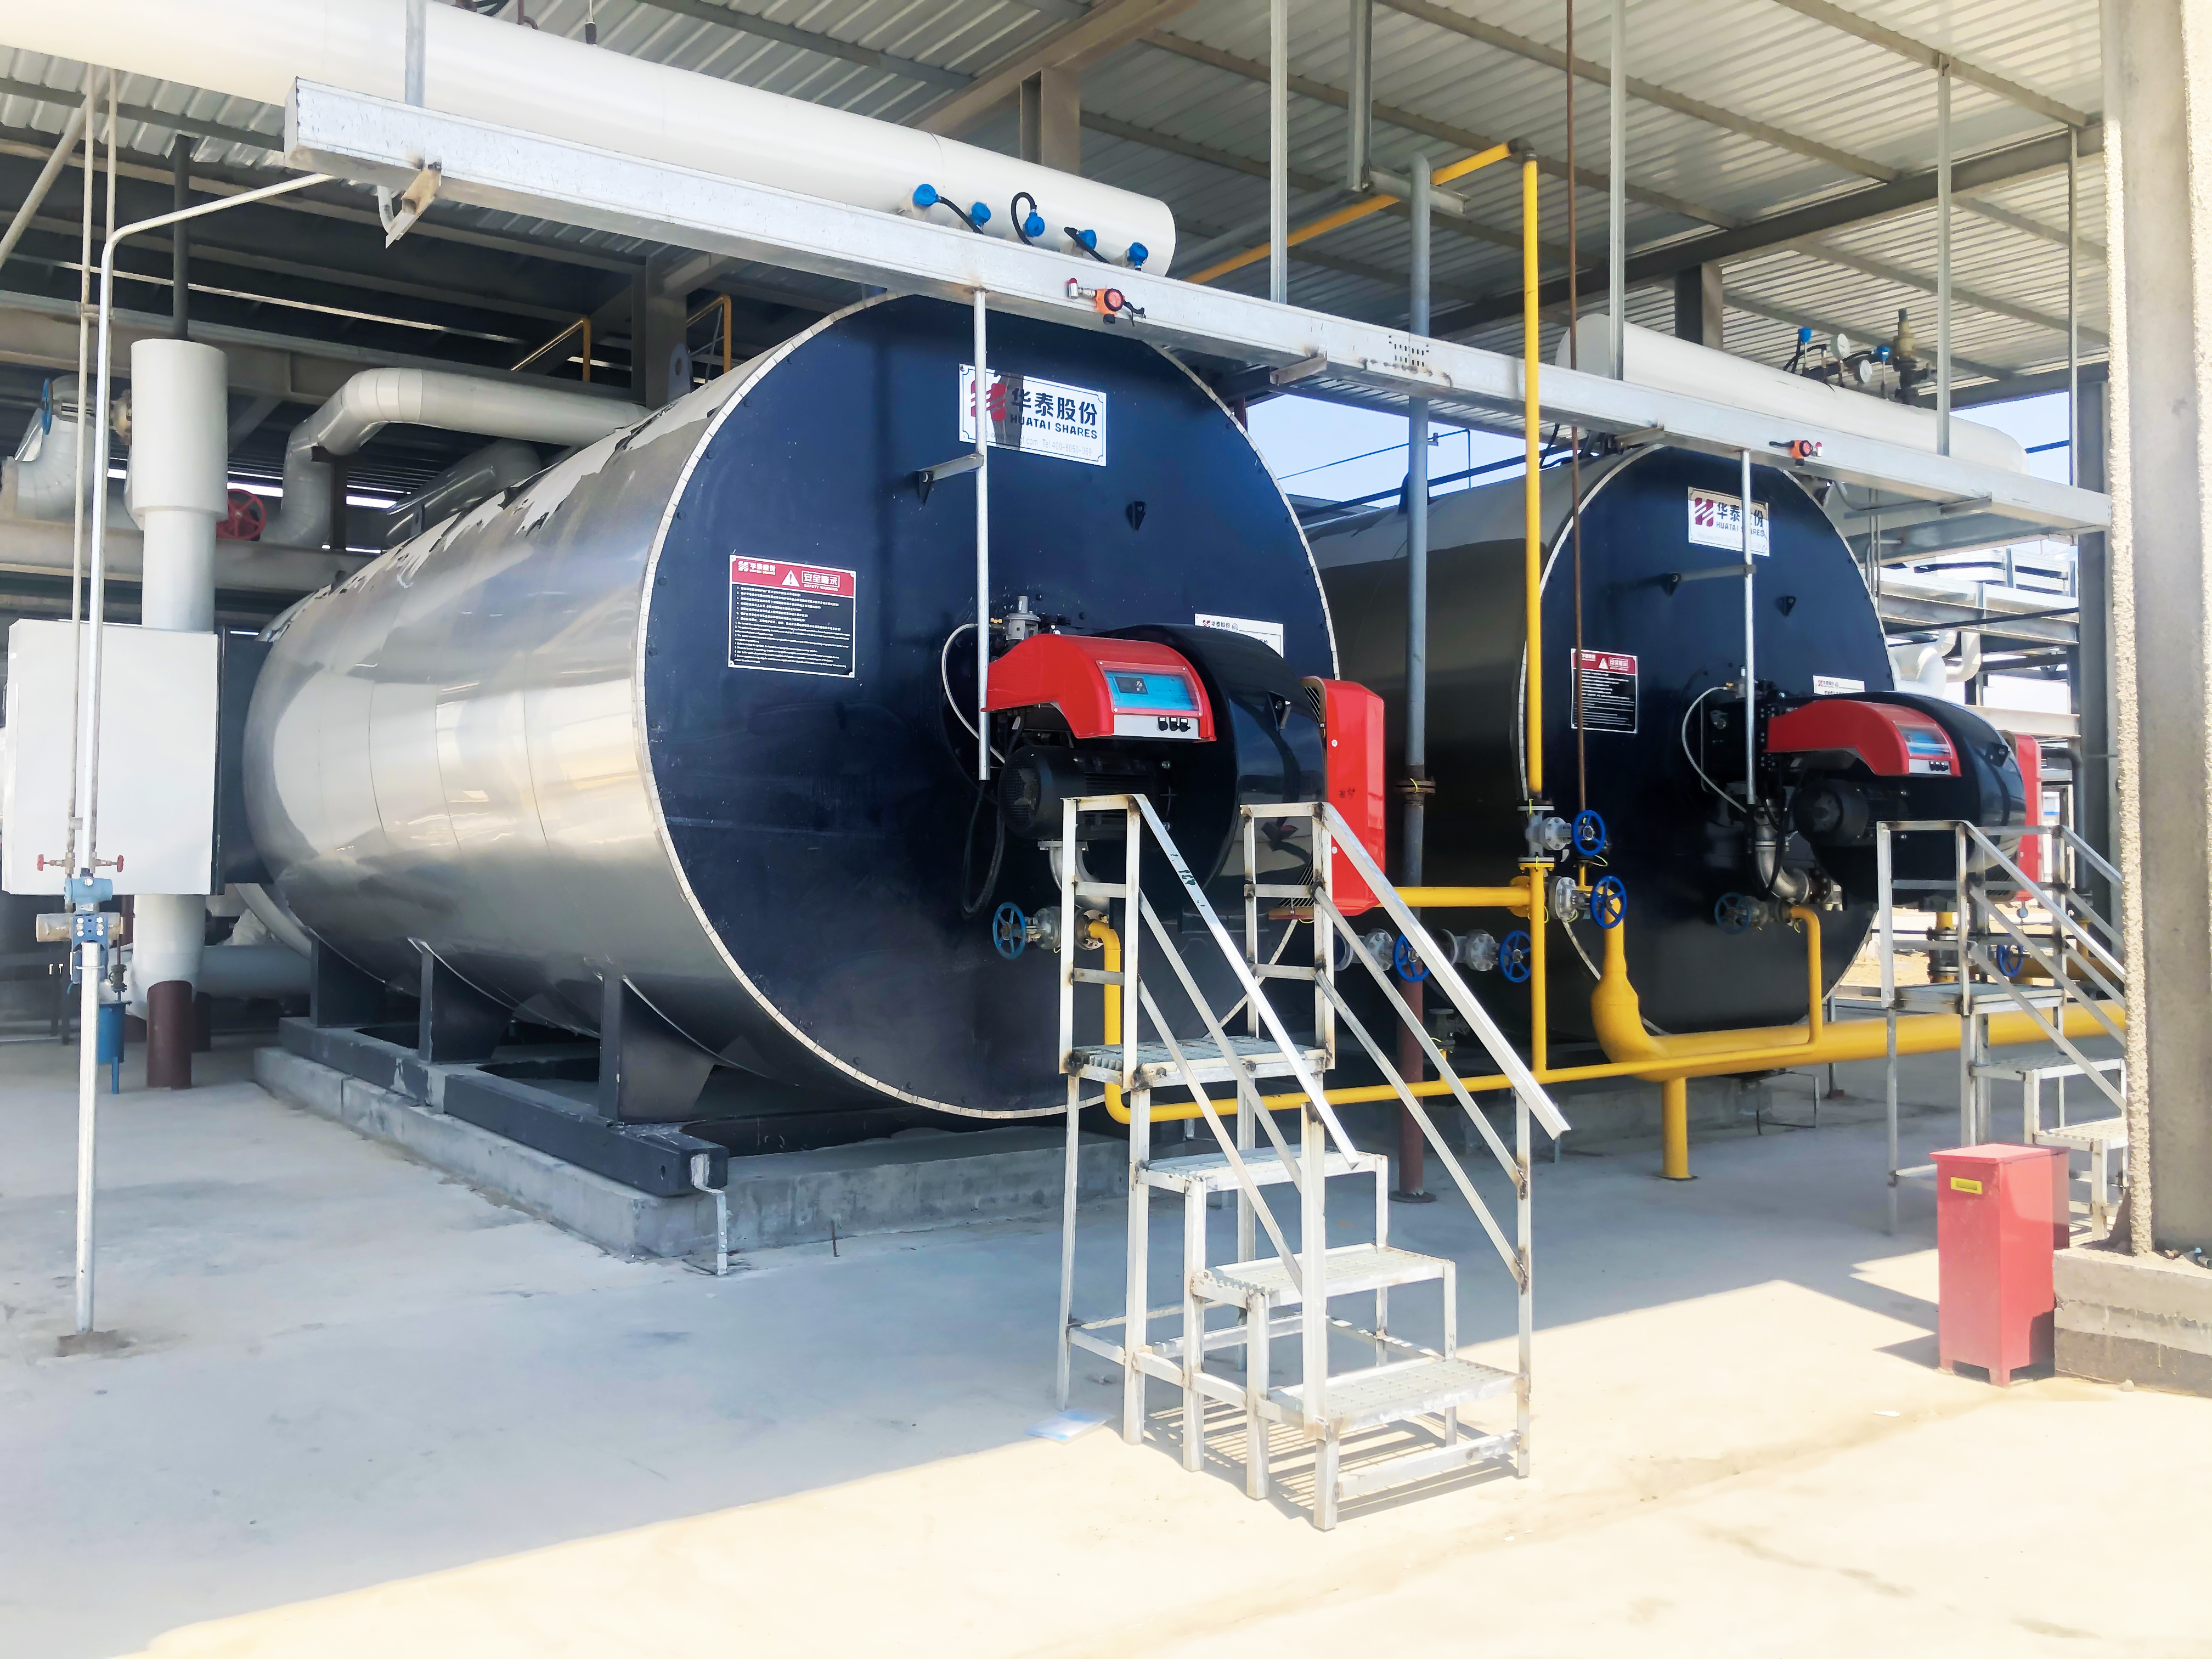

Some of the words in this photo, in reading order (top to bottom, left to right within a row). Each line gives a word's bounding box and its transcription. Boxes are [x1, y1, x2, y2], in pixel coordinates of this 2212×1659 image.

[1011, 387, 1097, 426] 华泰股份
[1011, 414, 1051, 430] HUATAI
[1055, 423, 1097, 439] SHARES
[1052, 441, 1092, 456] 400-8050-369
[1717, 501, 1763, 527] 华泰份
[1716, 521, 1739, 532] HUATAI
[1741, 526, 1764, 537] RES
